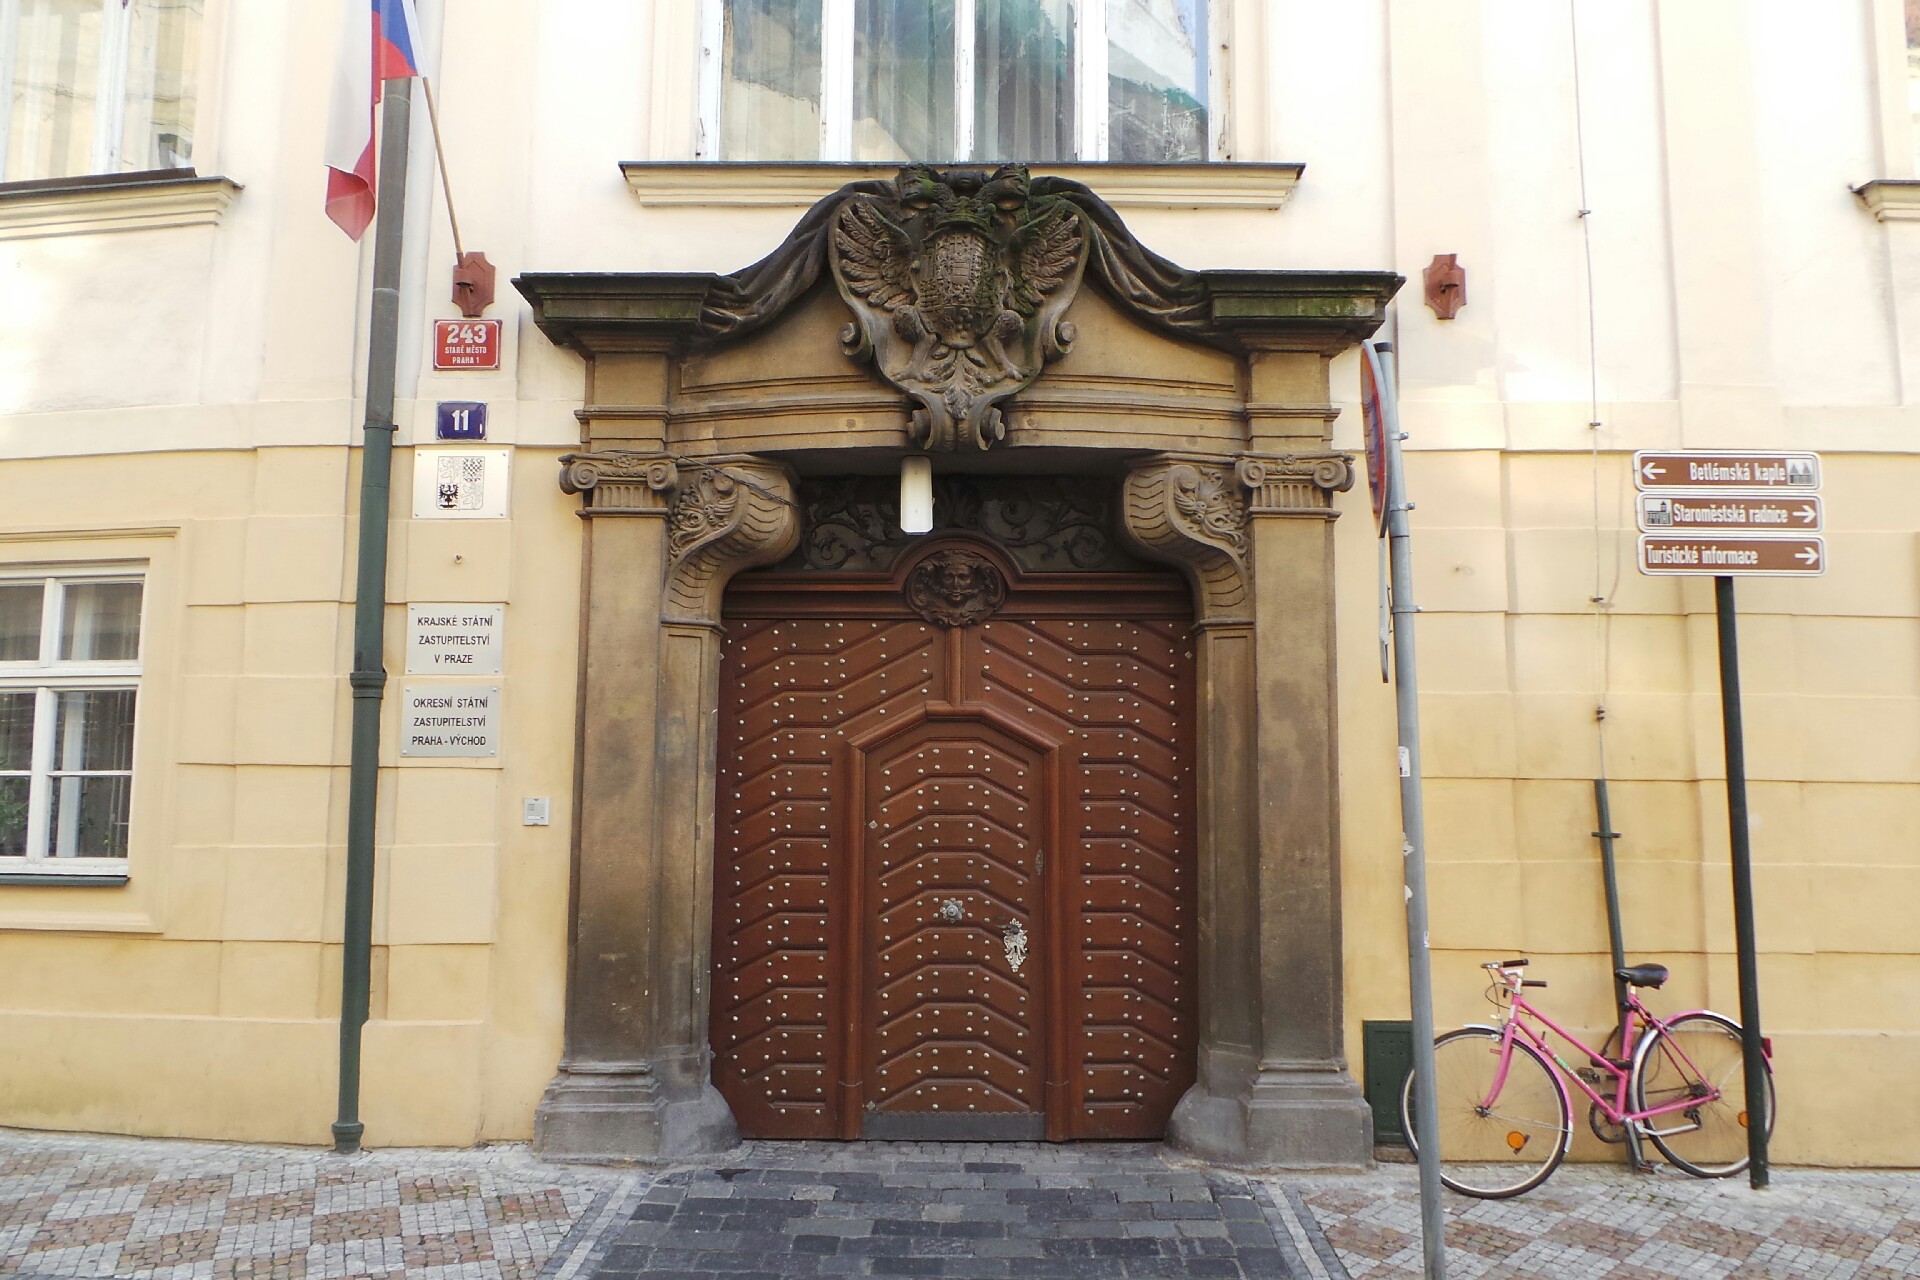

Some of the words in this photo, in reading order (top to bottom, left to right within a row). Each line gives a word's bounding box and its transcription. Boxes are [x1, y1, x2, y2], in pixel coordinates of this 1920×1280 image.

[446, 324, 487, 344] 243
[444, 345, 464, 354] STARÉ
[465, 345, 487, 354] MĚSTO
[452, 356, 474, 365] PRAHA
[475, 356, 480, 364] 1
[451, 409, 469, 431] 11
[1690, 462, 1750, 481] Betlémská
[1754, 463, 1786, 485] kaple
[1673, 503, 1746, 523] Staroměstská
[1749, 504, 1788, 523] radnice
[1646, 545, 1699, 564] Turistické
[1701, 545, 1759, 565] informace
[417, 615, 458, 627] KRAJSKÉ
[461, 615, 493, 627] STÁTNÍ
[418, 633, 491, 646] ZASTUPITELSTVÍ
[434, 654, 441, 664] V
[444, 654, 474, 664] PRAZE
[413, 696, 453, 709] OKRESNÍ
[456, 696, 489, 709] STÁTNÍ
[413, 715, 487, 727] ZASTUPITELSTVÍ
